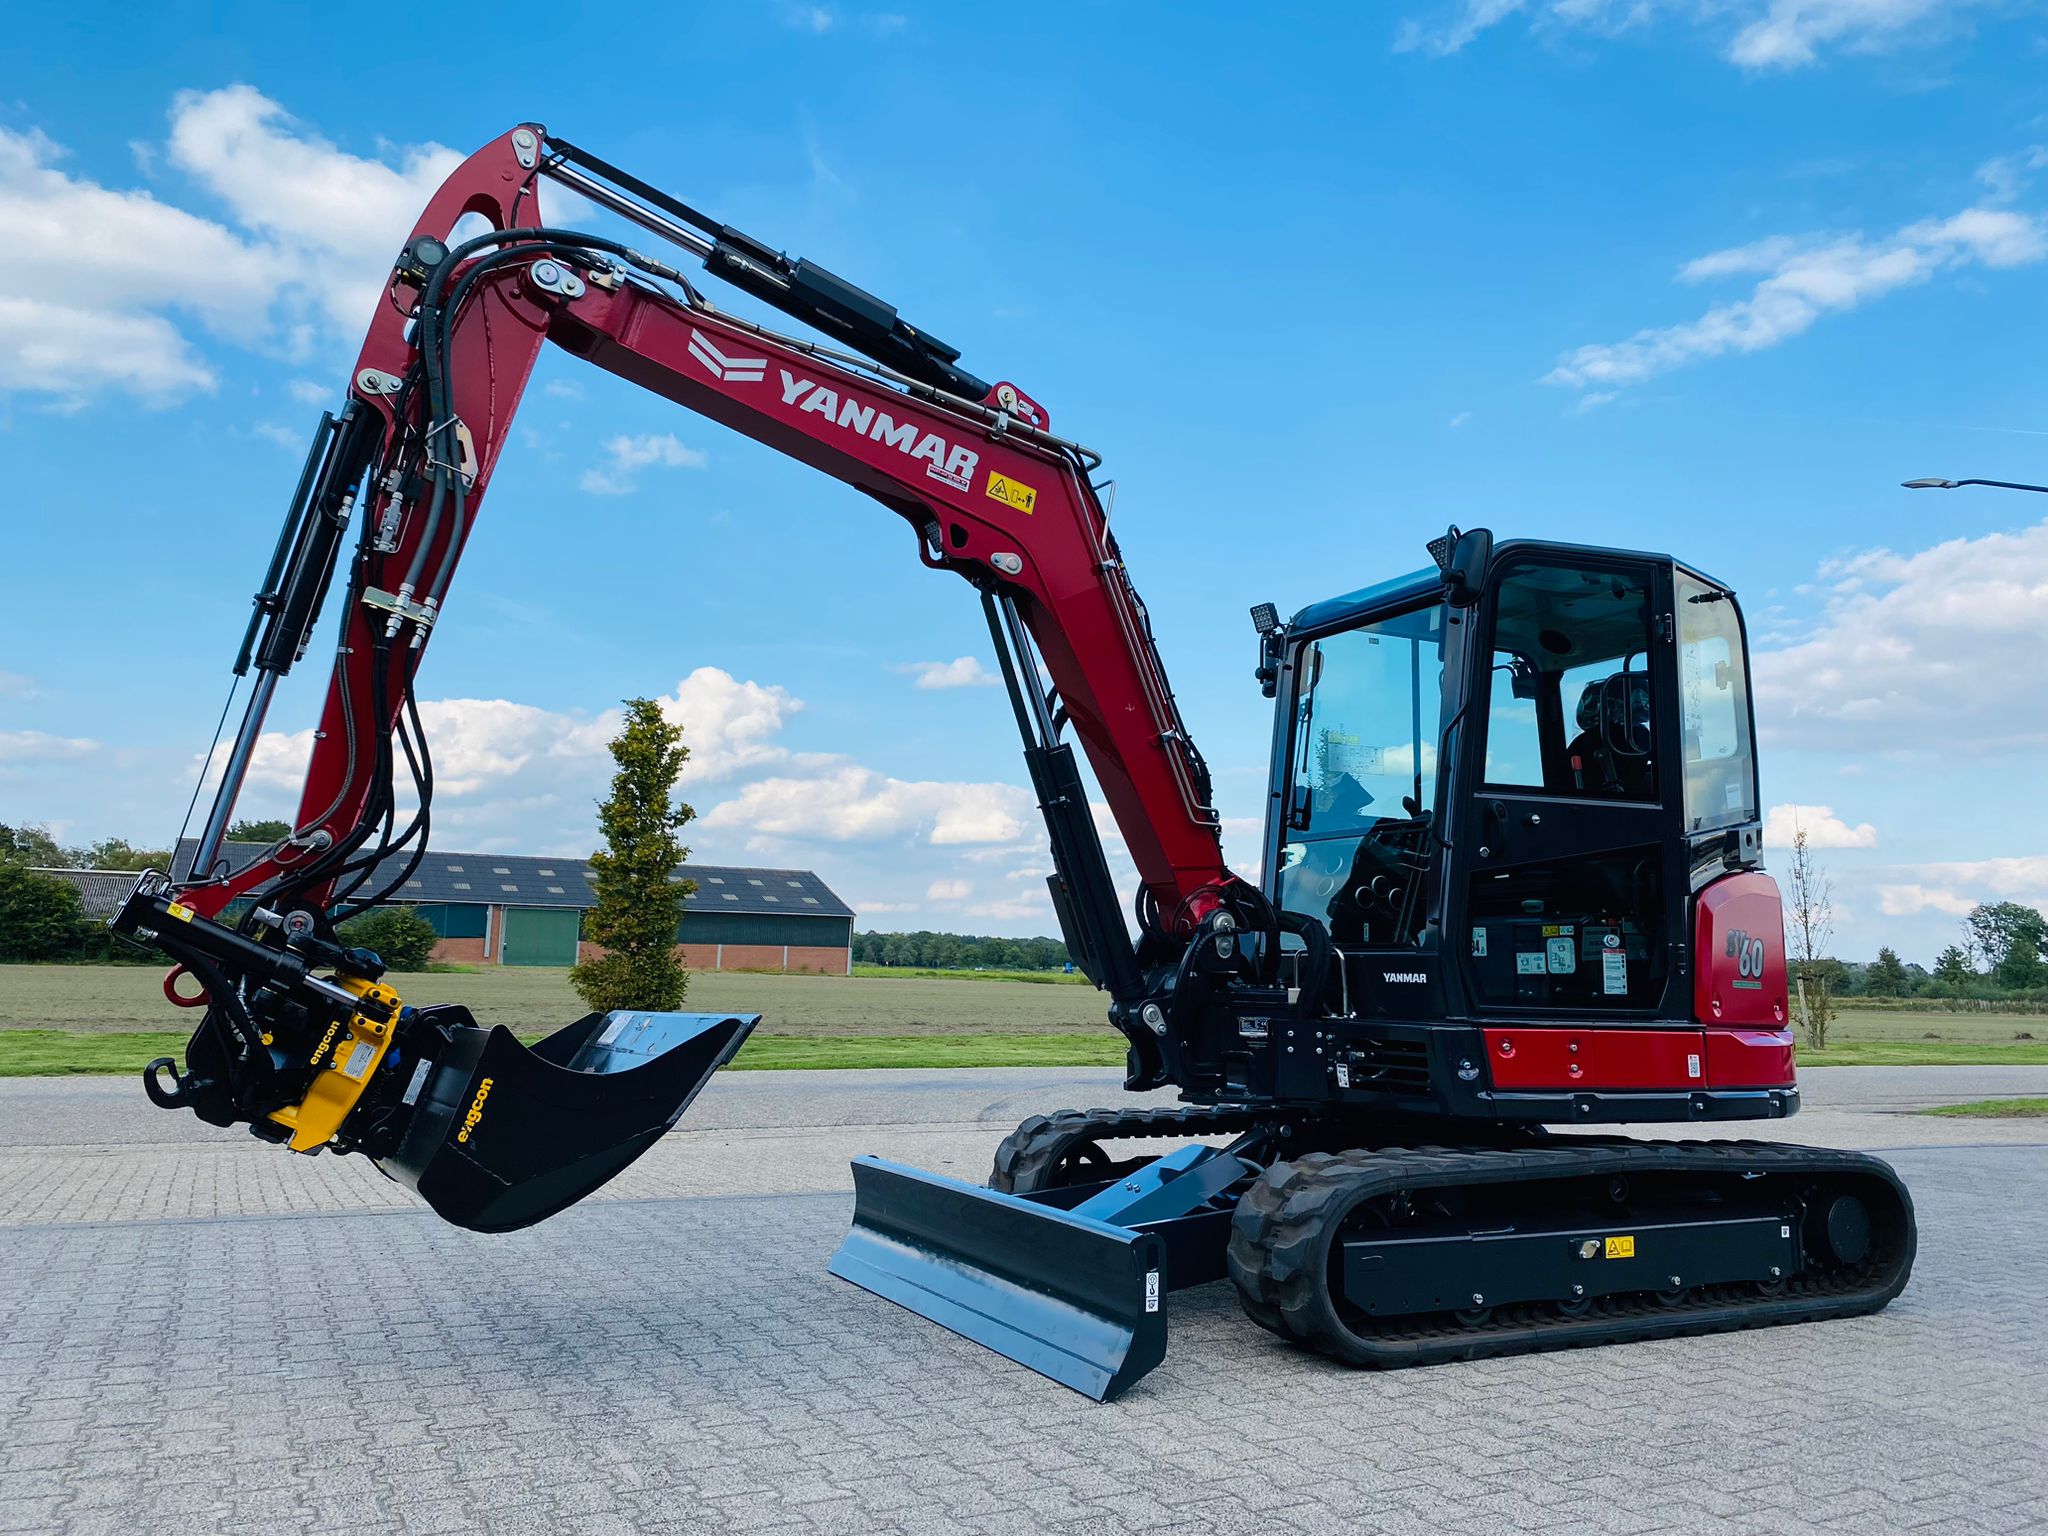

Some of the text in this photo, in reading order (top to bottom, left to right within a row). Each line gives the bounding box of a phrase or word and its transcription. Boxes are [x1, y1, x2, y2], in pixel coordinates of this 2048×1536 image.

[779, 369, 981, 480] YANMAR
[1383, 972, 1427, 983] YANMAR
[310, 1020, 341, 1065] engcon
[457, 1077, 494, 1143] engcon
